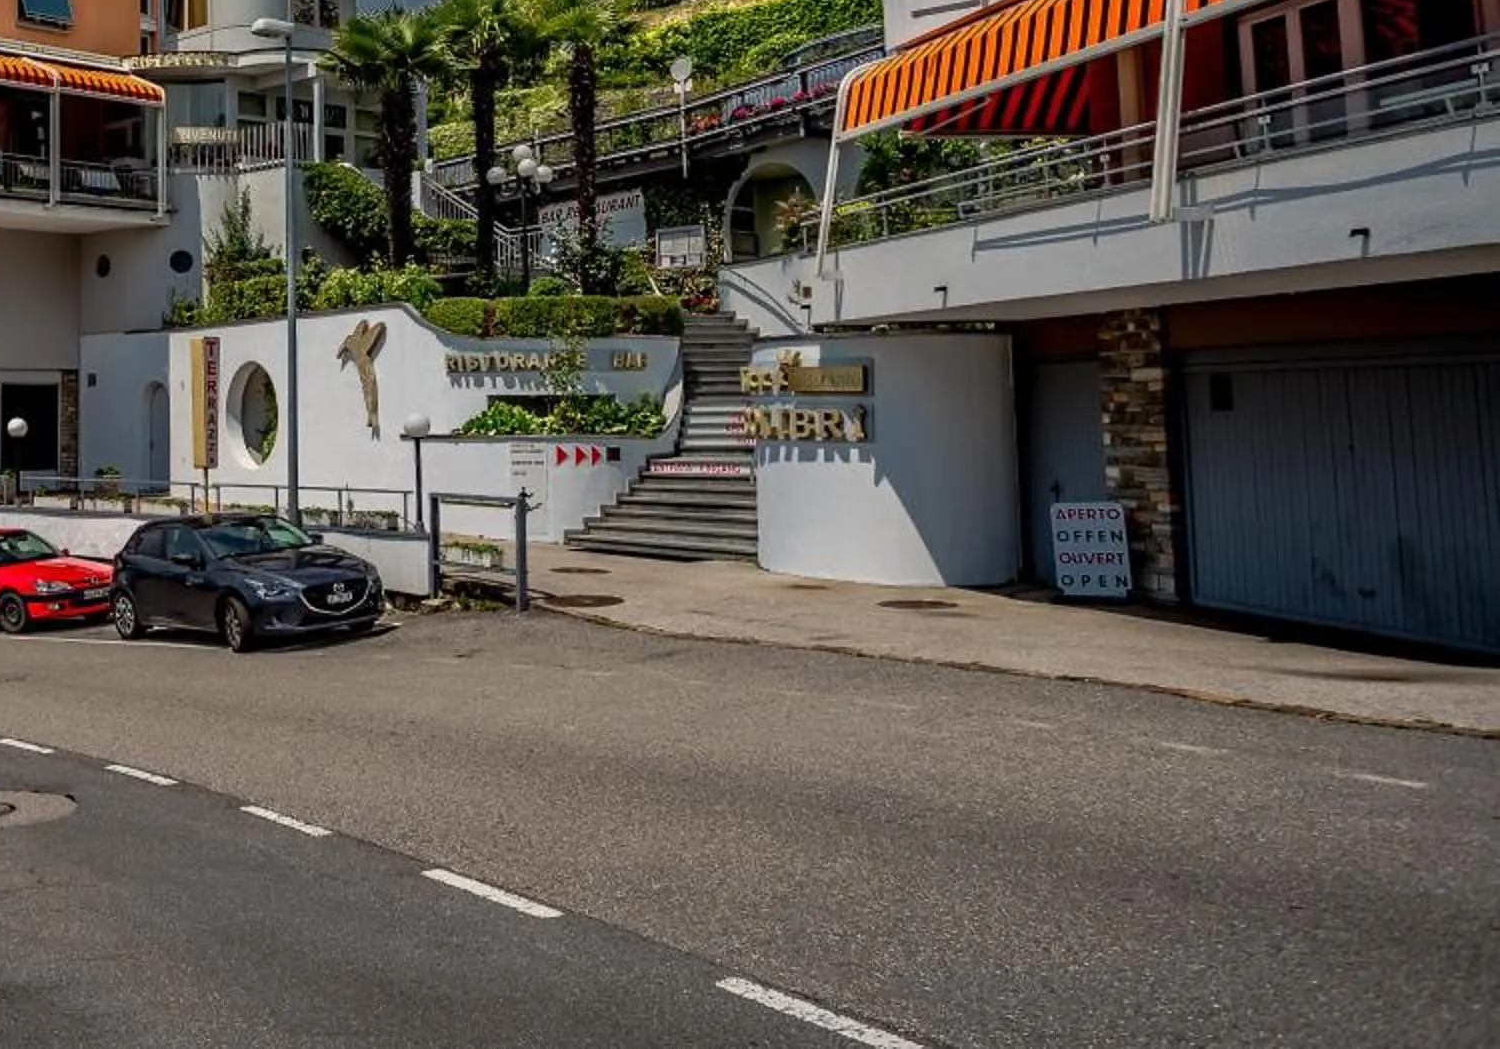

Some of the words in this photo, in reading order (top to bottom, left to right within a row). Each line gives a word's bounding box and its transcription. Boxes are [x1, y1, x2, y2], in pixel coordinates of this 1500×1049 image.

[567, 194, 641, 220] REAURANT
[444, 352, 587, 372] RISTORANE
[1056, 508, 1120, 519] APERTO
[1056, 530, 1123, 542] OFFEN
[1060, 553, 1124, 564] OUVERT
[1061, 574, 1129, 587] OPEN
